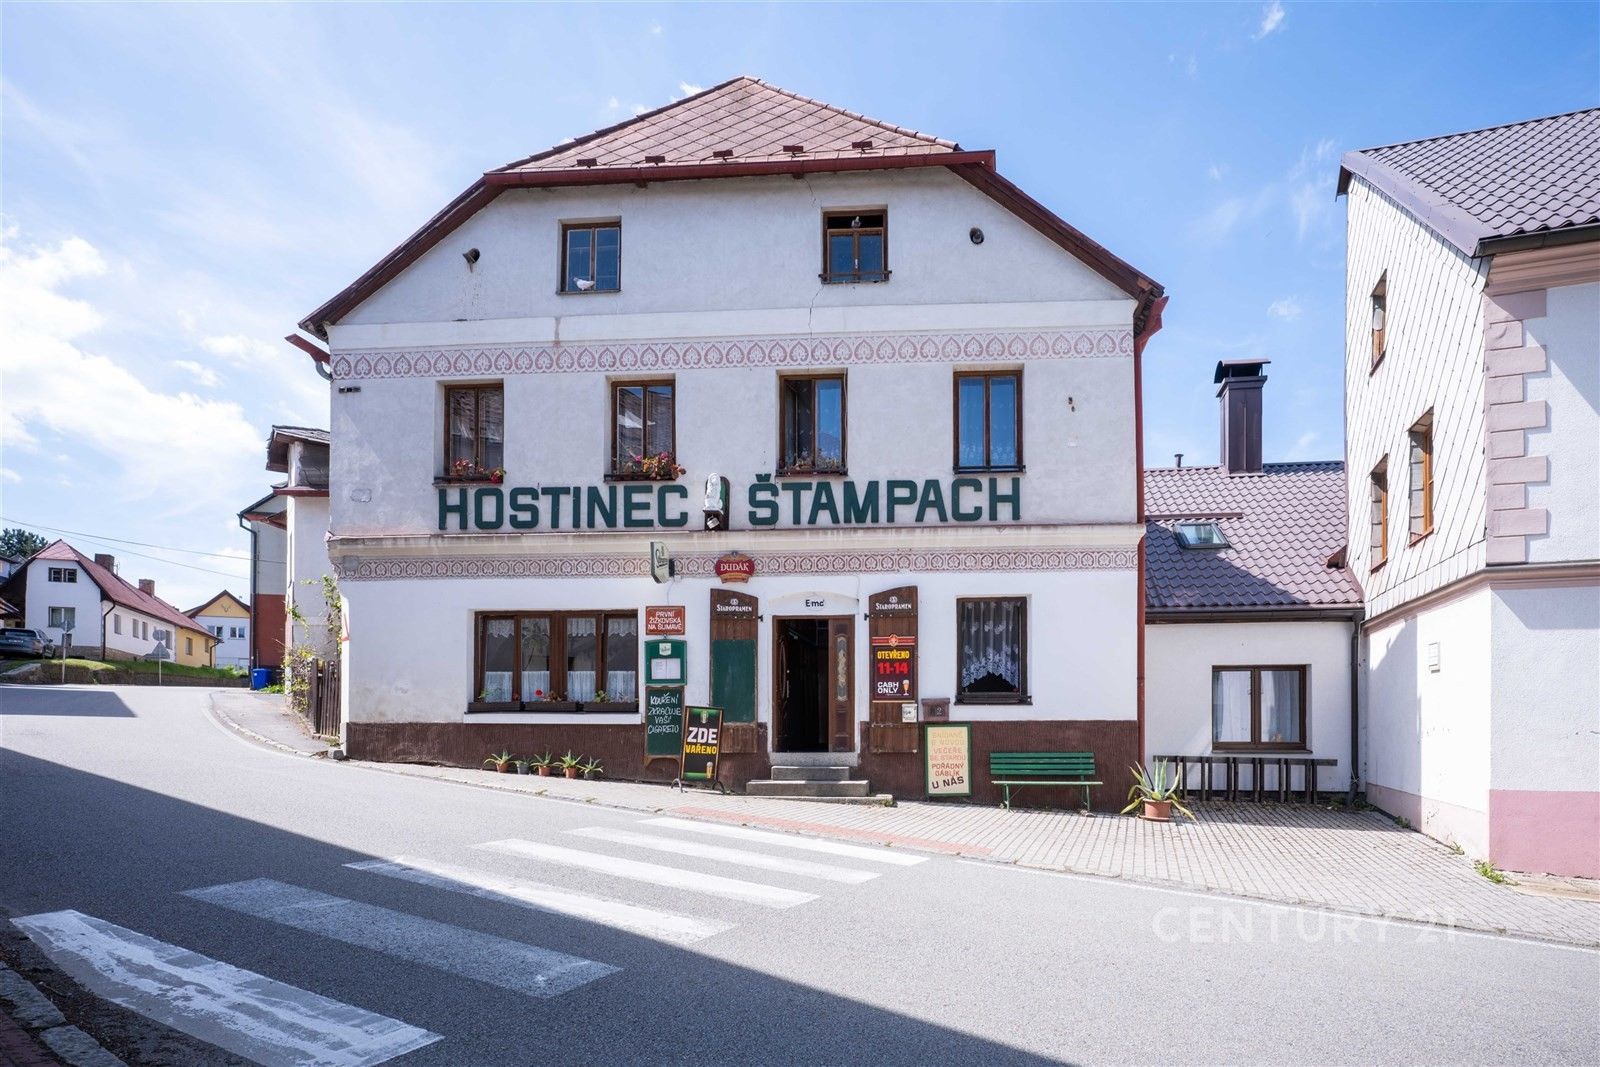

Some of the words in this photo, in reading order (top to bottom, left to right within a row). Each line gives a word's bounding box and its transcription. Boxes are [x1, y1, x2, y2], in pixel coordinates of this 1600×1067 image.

[438, 484, 688, 530] HOSTINEC
[748, 473, 1021, 526] ŠTAMPACH
[720, 562, 749, 571] DUDÁK
[877, 649, 910, 659] OTEVŘENO
[878, 662, 909, 674] 11-14
[686, 726, 718, 744] ZDE
[685, 744, 717, 754] VAŘENO
[931, 780, 940, 789] U
